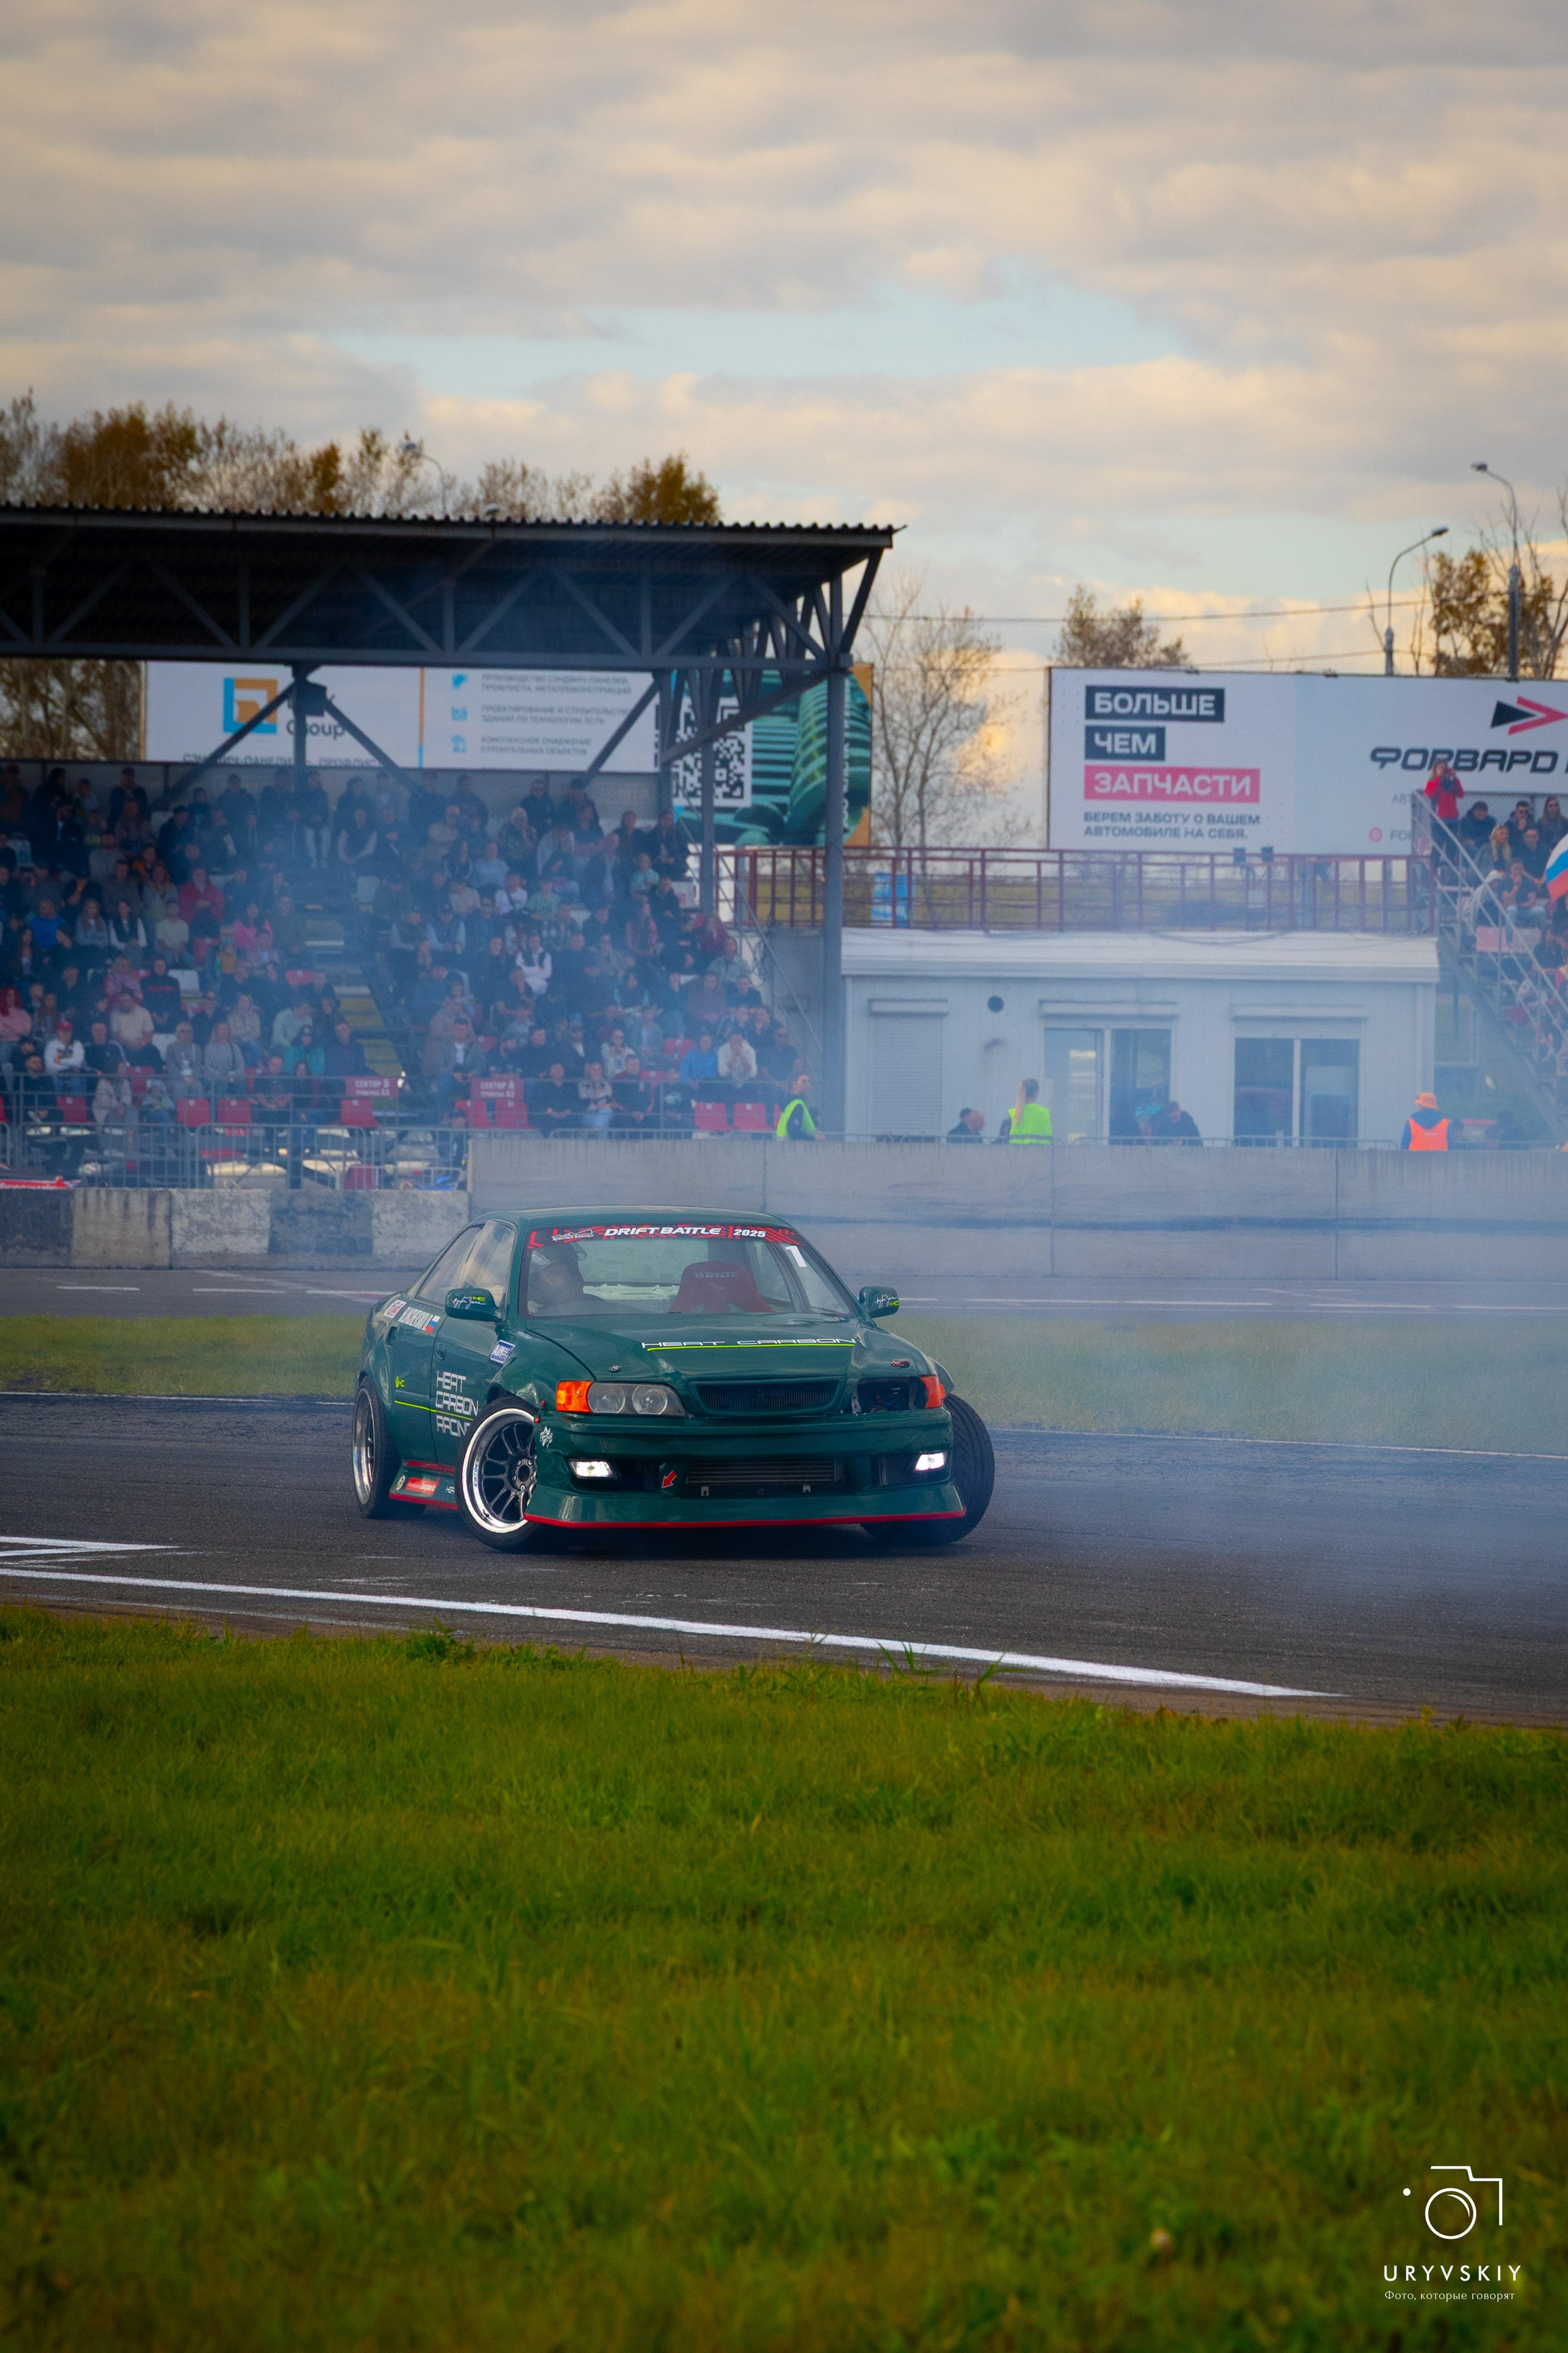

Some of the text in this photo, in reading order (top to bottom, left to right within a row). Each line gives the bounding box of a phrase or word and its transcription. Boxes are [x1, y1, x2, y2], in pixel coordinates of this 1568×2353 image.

[1094, 692, 1216, 716] БОЛЬШЕ
[1094, 733, 1156, 755] ЧЕМ
[1094, 772, 1251, 796] ЗАПЧАСТИ
[1084, 811, 1260, 825] БЕРЕМ ЗАБОТУ О ВАШЕМ
[1084, 826, 1180, 837] АВТОМОБИЛЕ
[1184, 828, 1204, 838] НА
[604, 1226, 766, 1237] DRIFT BATTLE 2025
[785, 1245, 807, 1267] 1
[436, 1370, 466, 1393] HEAT
[435, 1391, 479, 1416] CARBON
